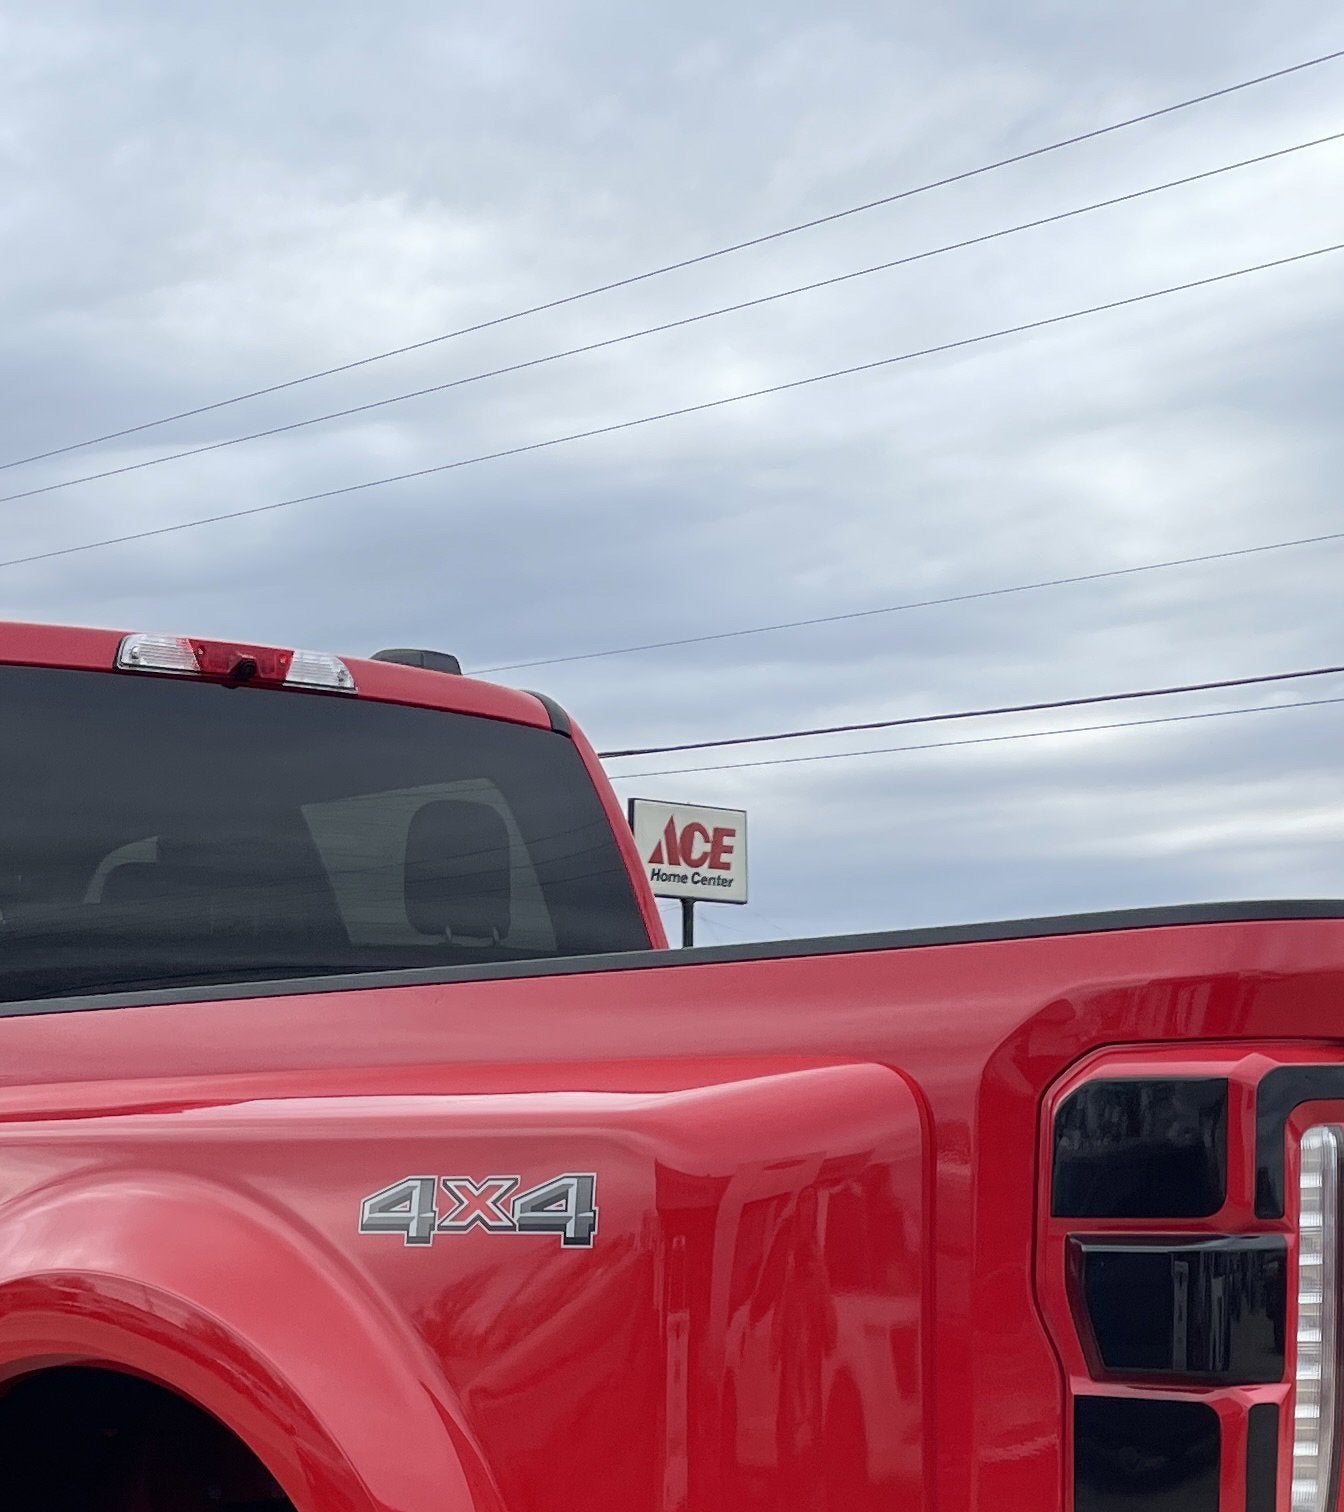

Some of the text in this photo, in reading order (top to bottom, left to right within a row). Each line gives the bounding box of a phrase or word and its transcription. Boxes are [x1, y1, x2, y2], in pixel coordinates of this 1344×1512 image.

[648, 815, 736, 871] ACE
[650, 868, 734, 888] Home Center
